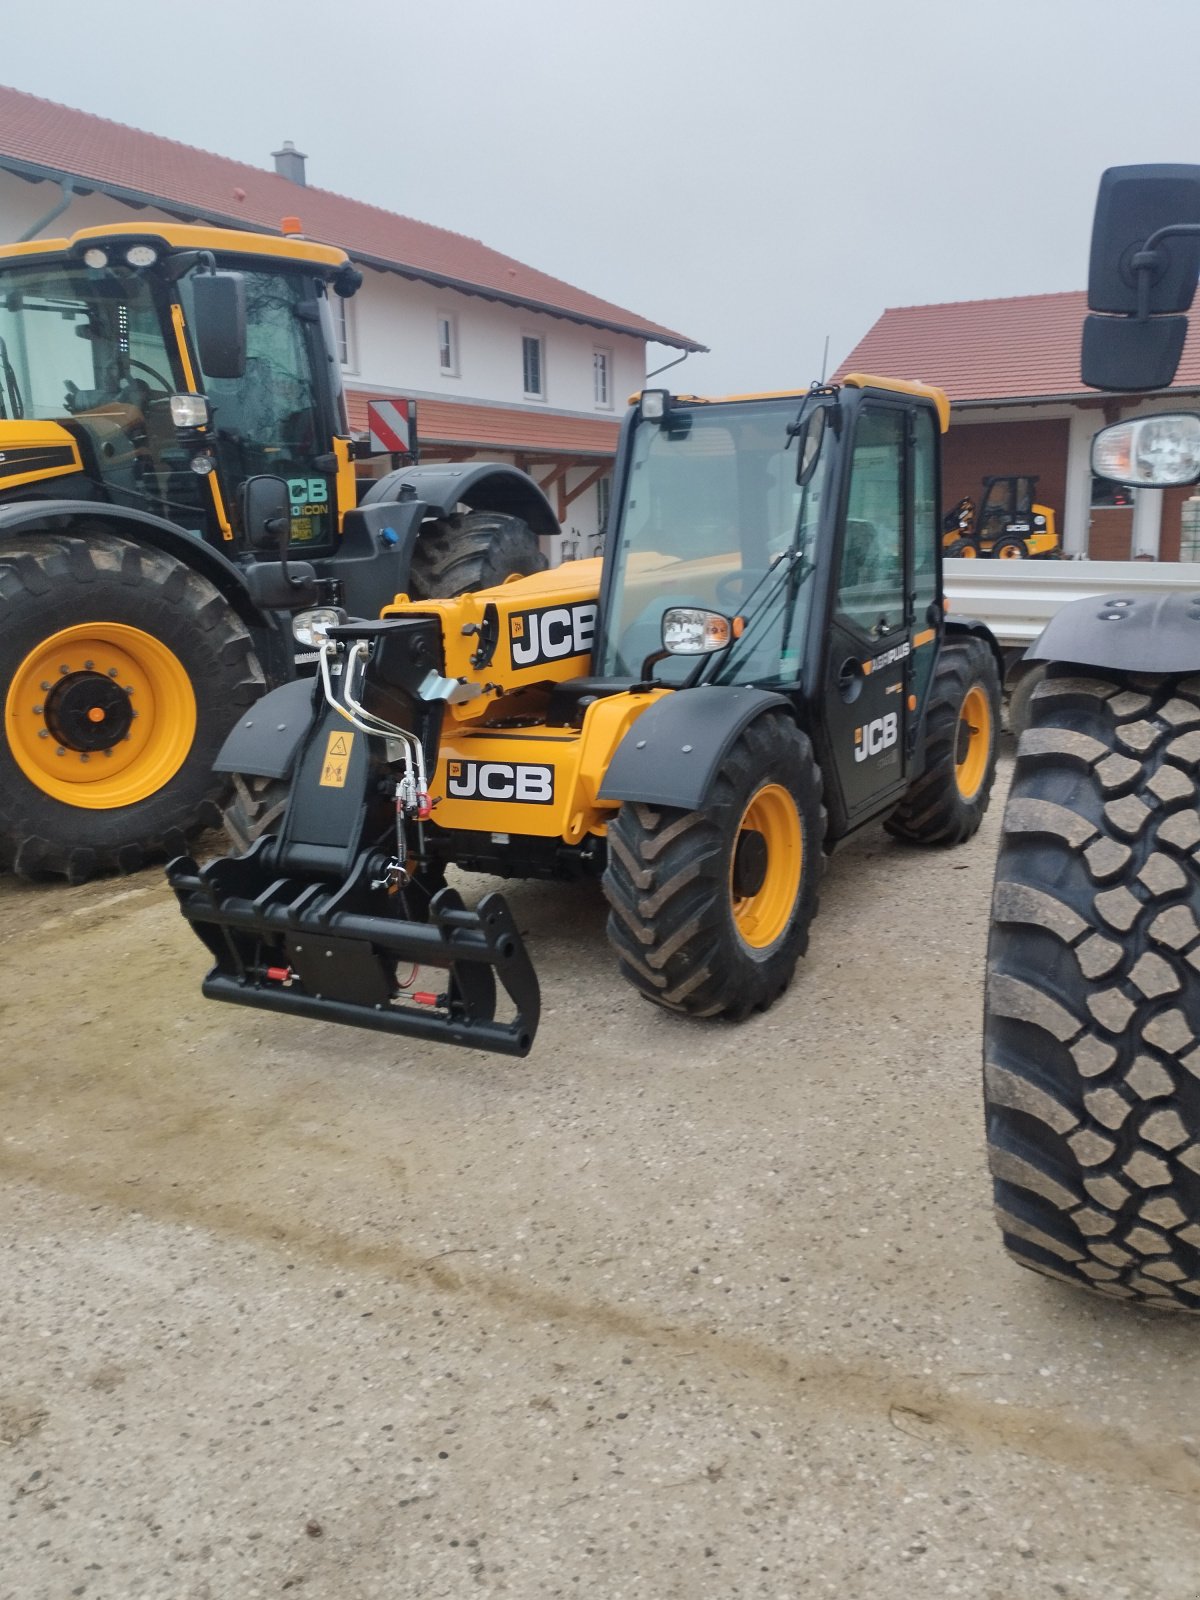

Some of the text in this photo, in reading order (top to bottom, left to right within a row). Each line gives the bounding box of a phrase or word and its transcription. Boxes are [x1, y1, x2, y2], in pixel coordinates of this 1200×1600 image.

[286, 478, 328, 504] CB
[511, 604, 599, 665] JCB
[854, 711, 898, 763] JCB
[448, 763, 553, 801] JCB
